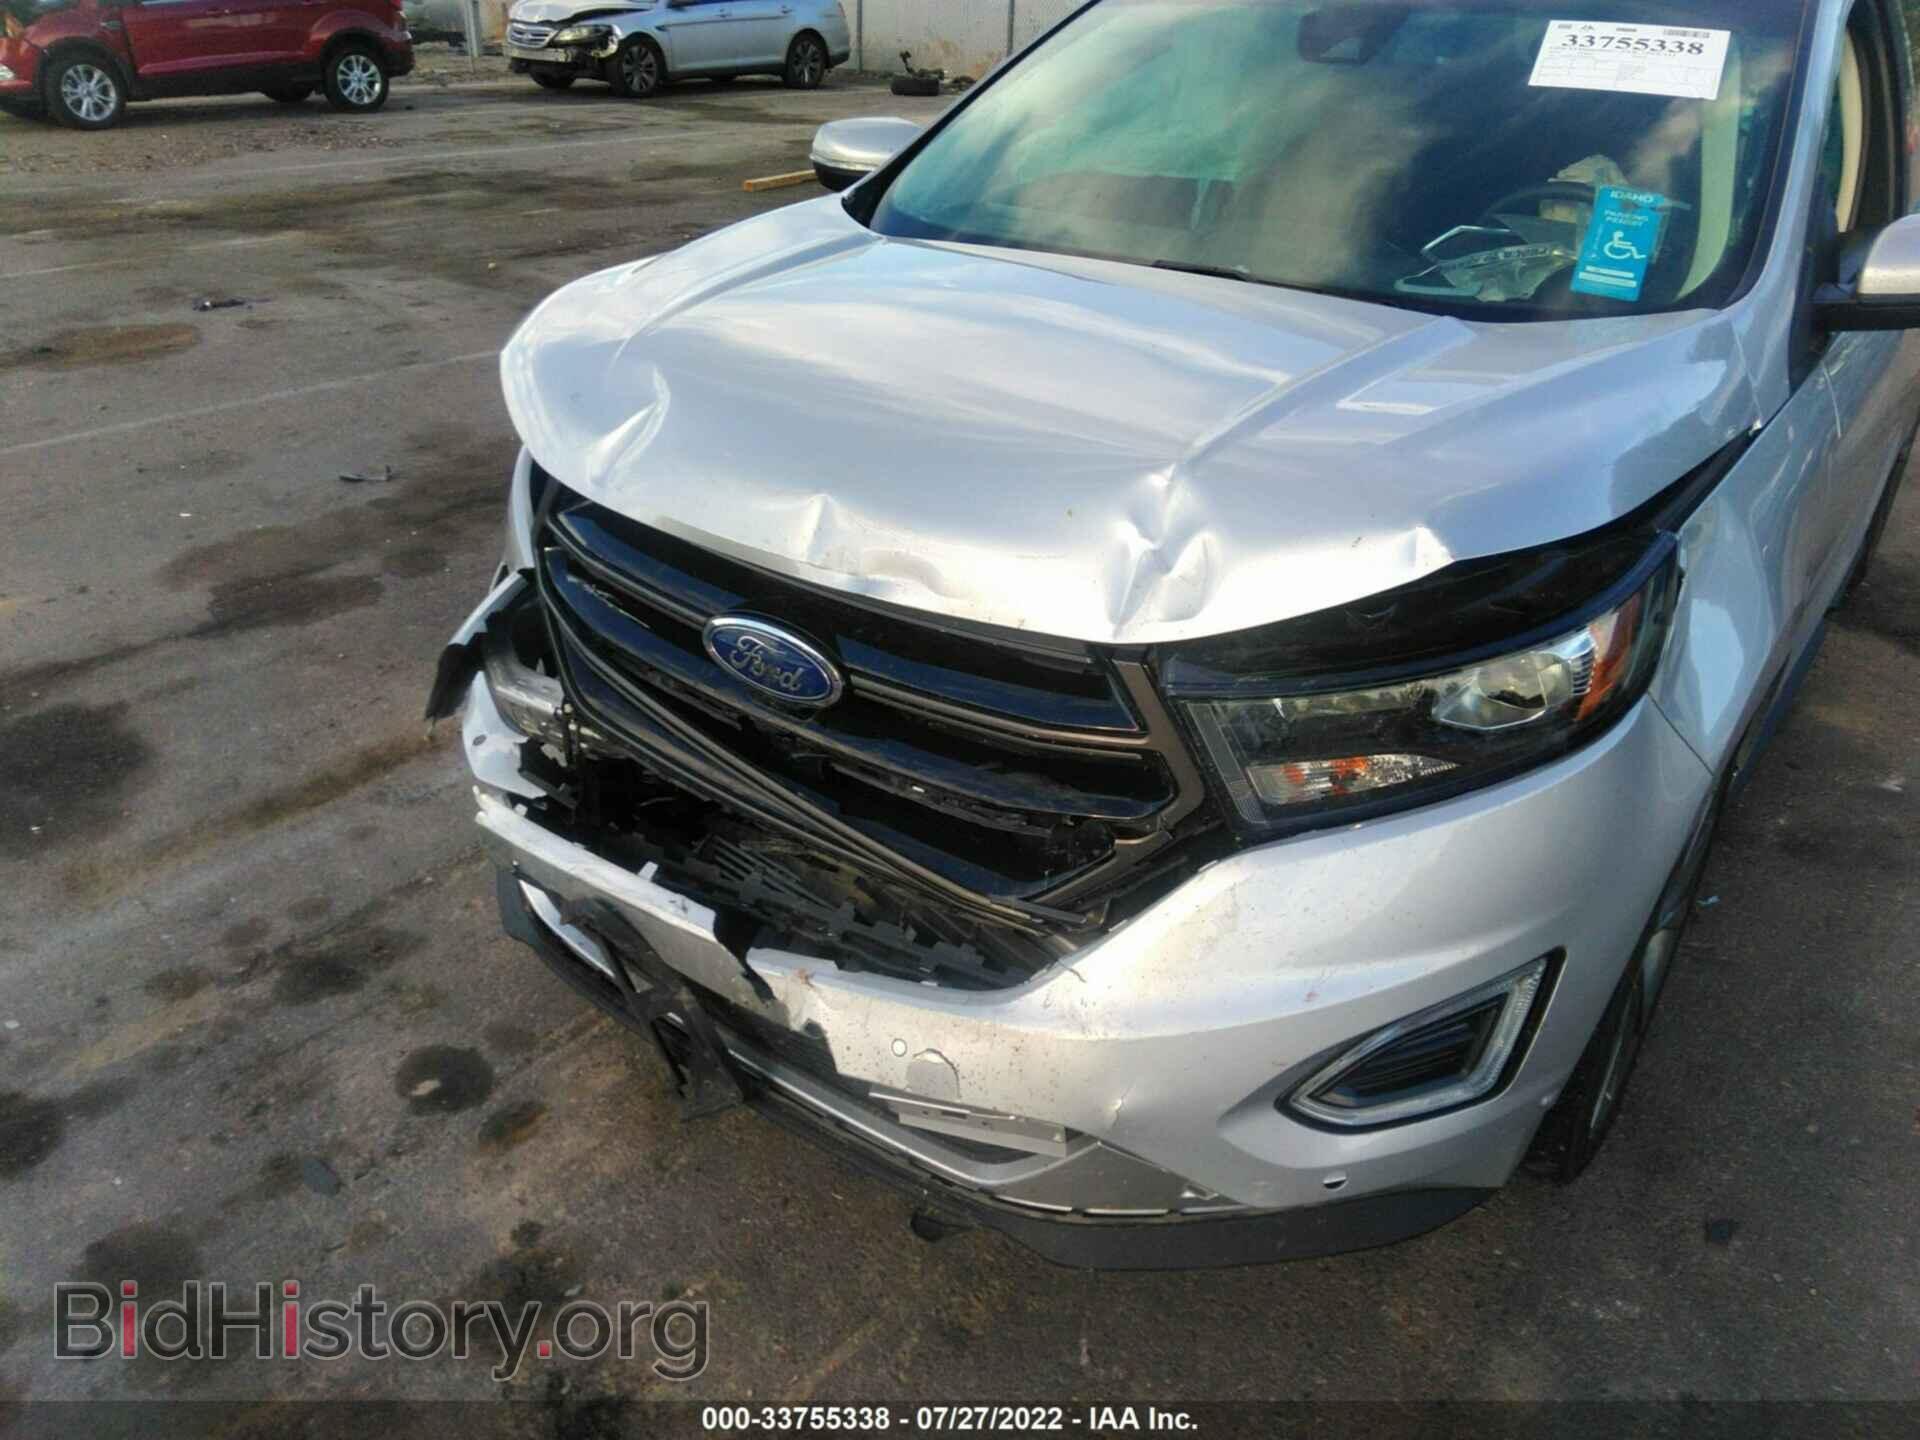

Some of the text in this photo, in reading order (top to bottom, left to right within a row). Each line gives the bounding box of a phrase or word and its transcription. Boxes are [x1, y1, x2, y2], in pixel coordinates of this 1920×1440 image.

[1560, 33, 1705, 56] 33755338
[1610, 190, 1654, 204] IDAHO
[729, 635, 804, 691] Ford
